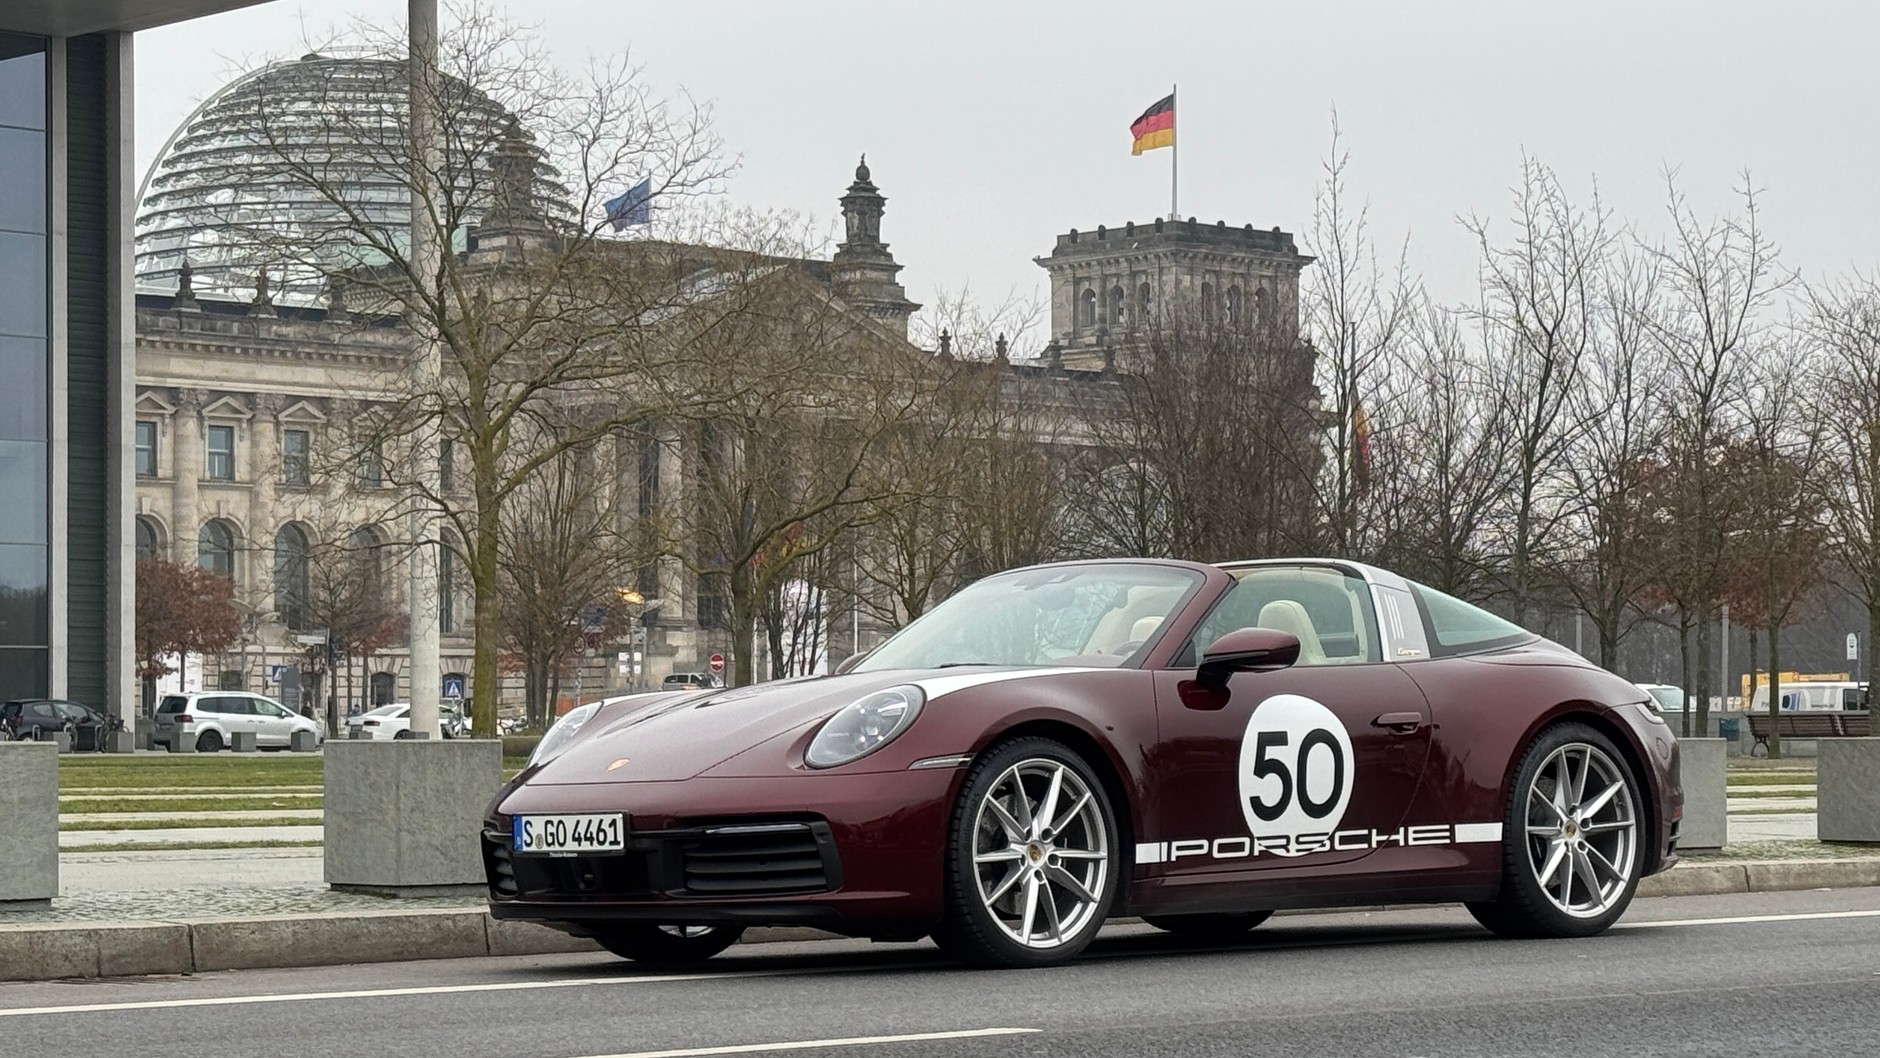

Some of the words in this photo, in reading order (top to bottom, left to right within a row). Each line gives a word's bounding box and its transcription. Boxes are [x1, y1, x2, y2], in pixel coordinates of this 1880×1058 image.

[1249, 728, 1345, 822] 50
[571, 818, 621, 847] 4461
[1170, 825, 1451, 862] PORSCHE
